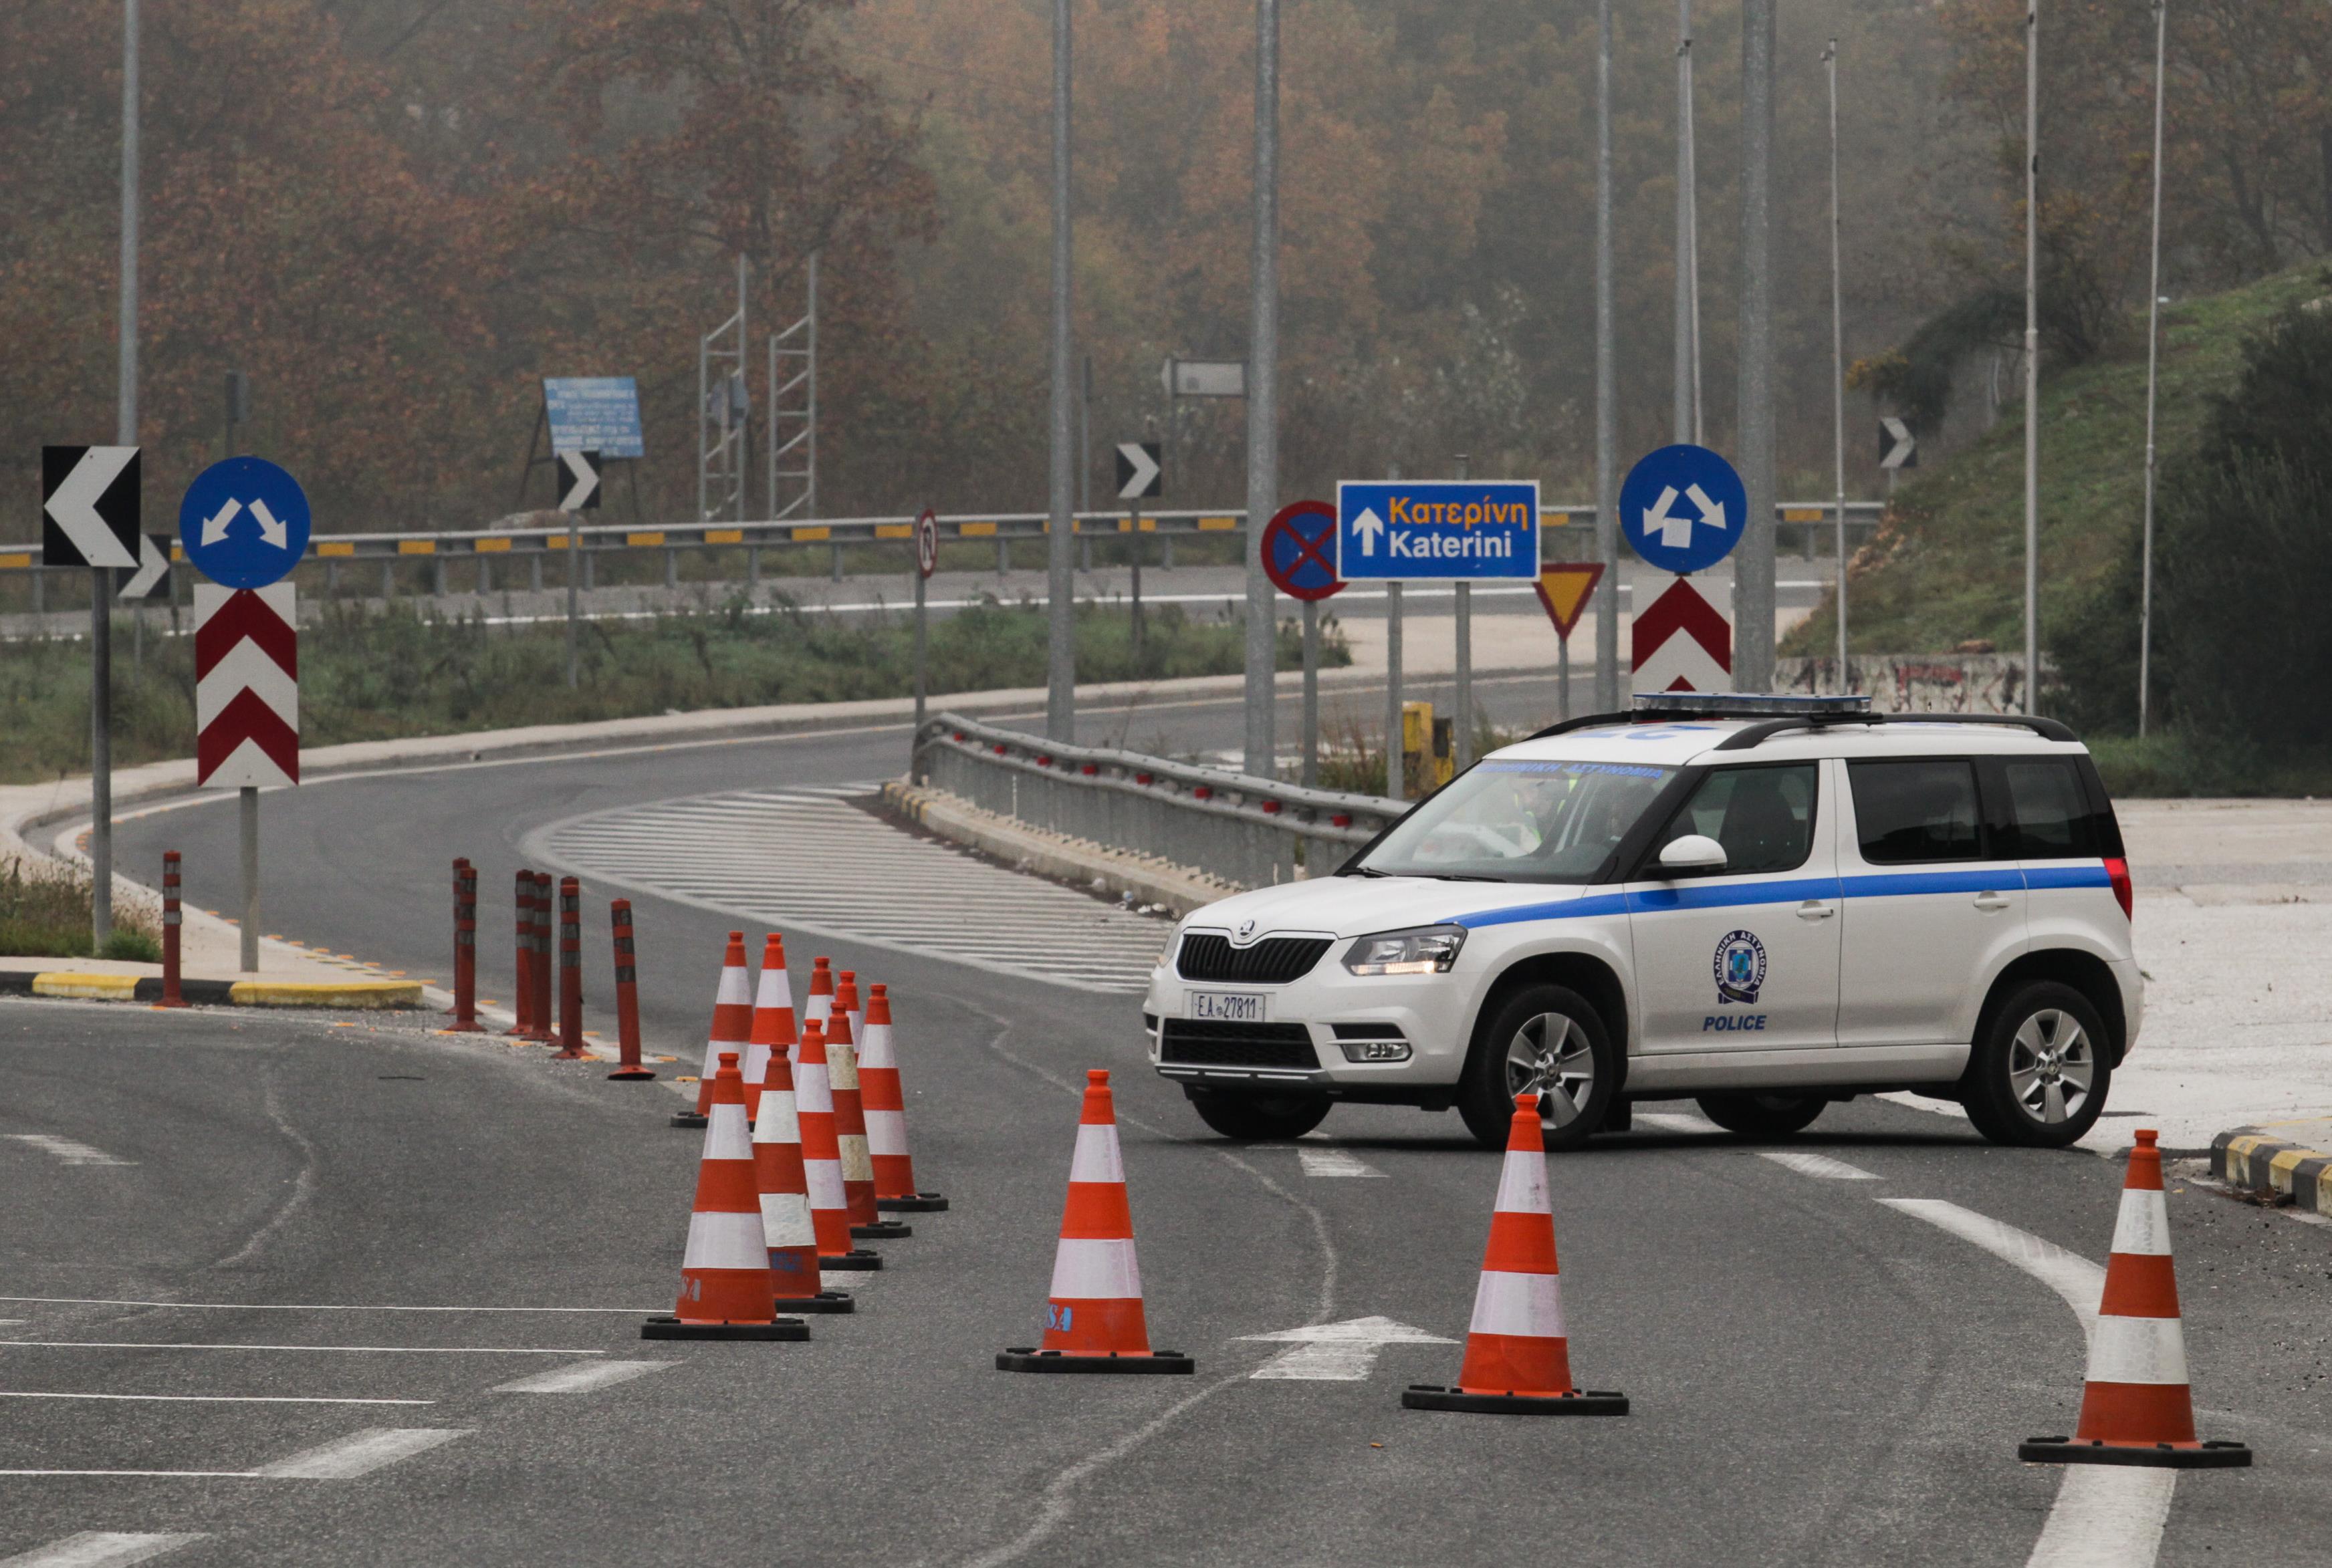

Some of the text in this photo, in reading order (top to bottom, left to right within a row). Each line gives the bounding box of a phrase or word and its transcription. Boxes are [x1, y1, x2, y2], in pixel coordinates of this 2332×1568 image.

[1389, 495, 1528, 531] Κατερίνη
[1389, 531, 1512, 557] Katerini
[1715, 932, 1766, 986] ΕΛΛΗΝΙΚΗ ΑΣΤΥΝΟΜΙΑ
[1223, 997, 1256, 1019] 27811
[1703, 1015, 1767, 1031] POLICE
